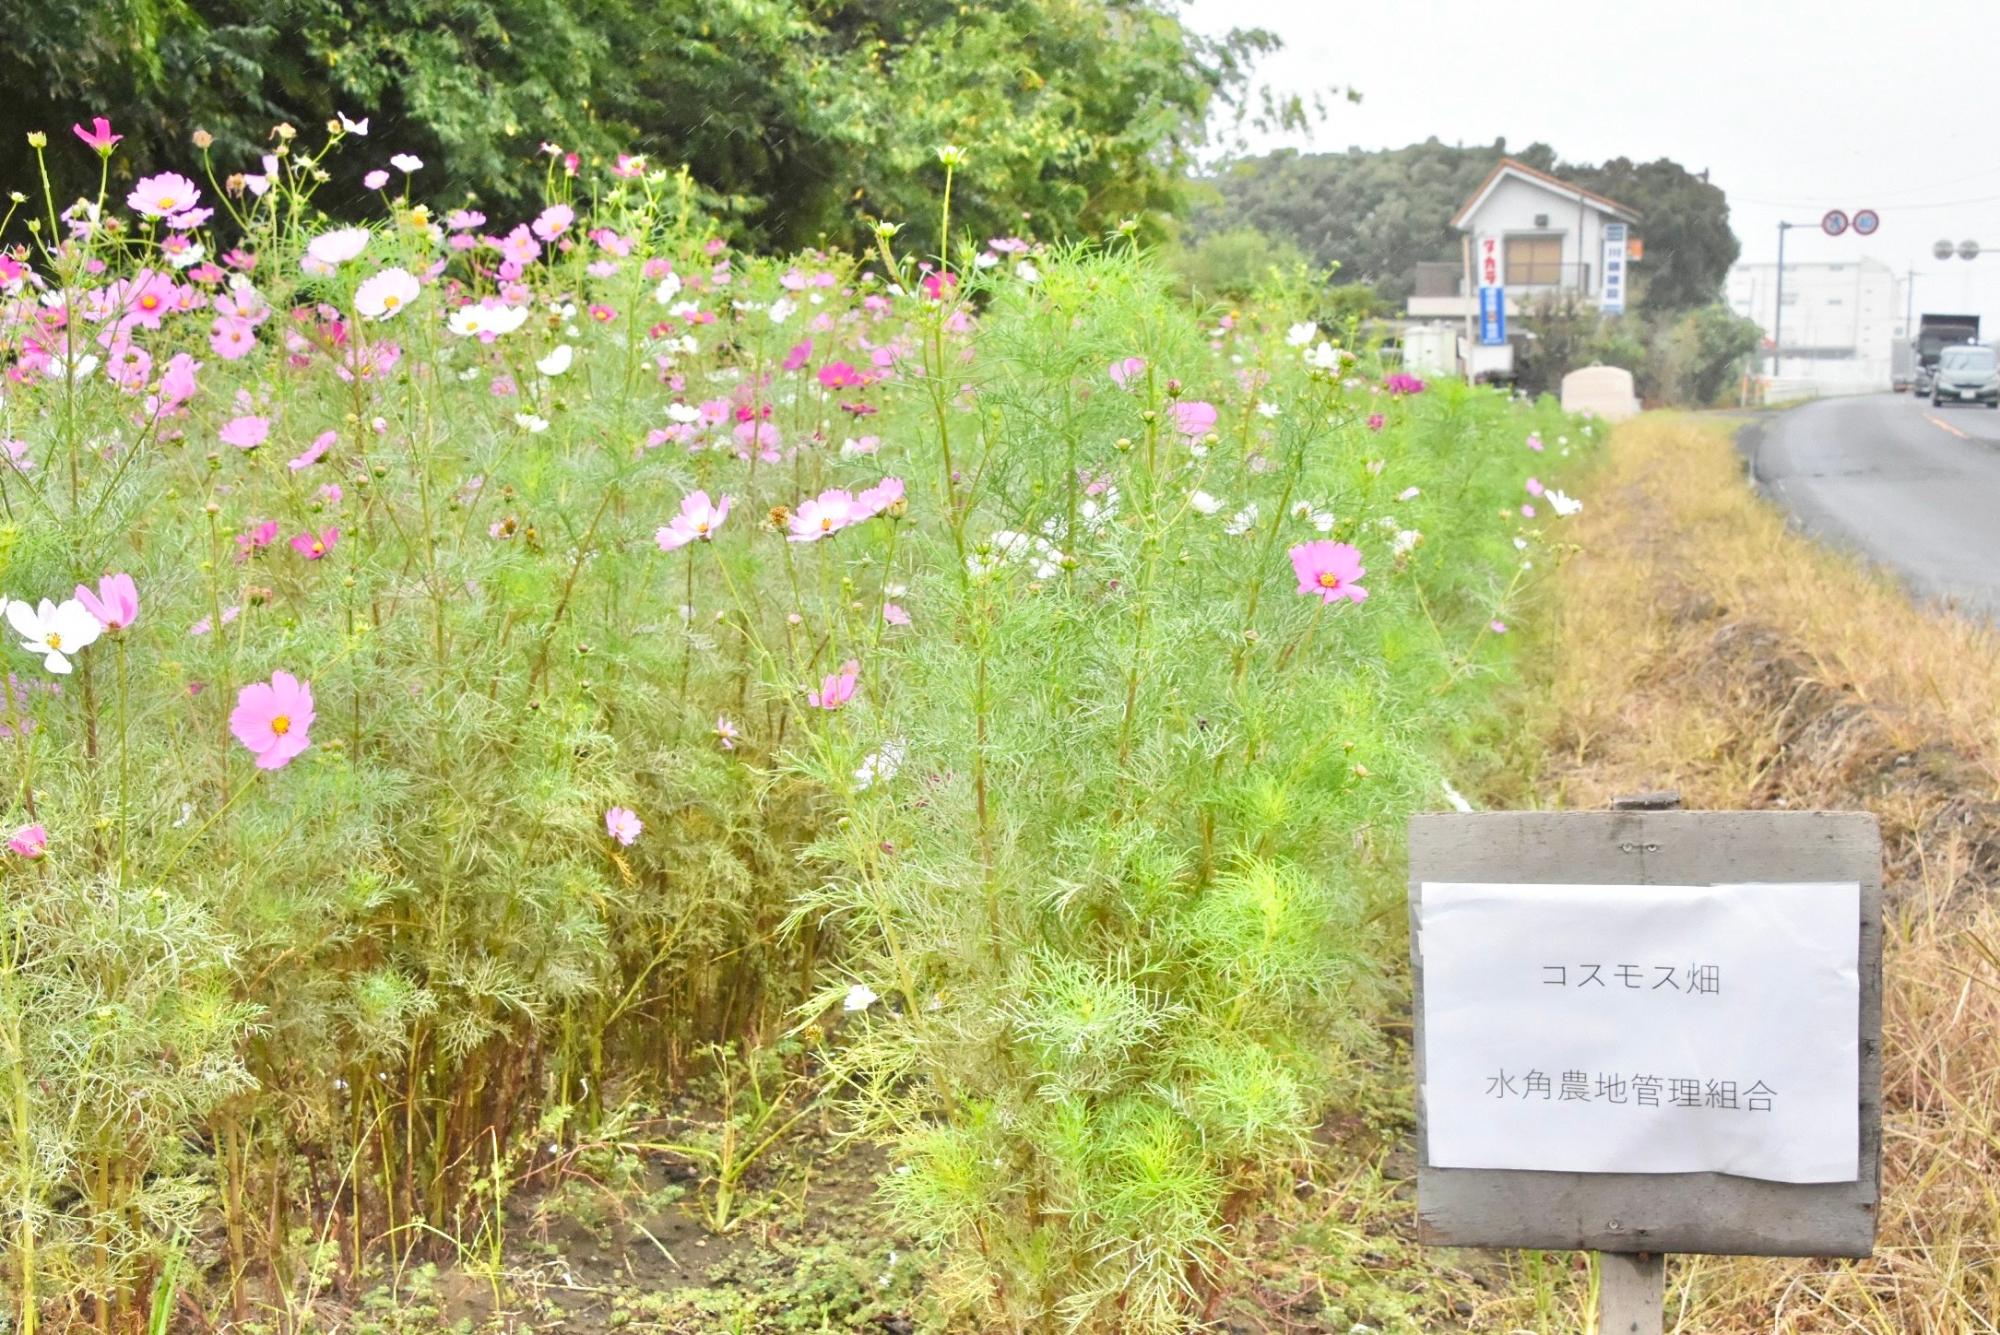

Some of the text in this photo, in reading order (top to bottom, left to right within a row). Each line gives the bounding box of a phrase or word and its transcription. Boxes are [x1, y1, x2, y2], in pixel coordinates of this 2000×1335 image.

[1542, 961, 1721, 995] コスモス畑
[1485, 1068, 1778, 1113] 水角農地管理組合
